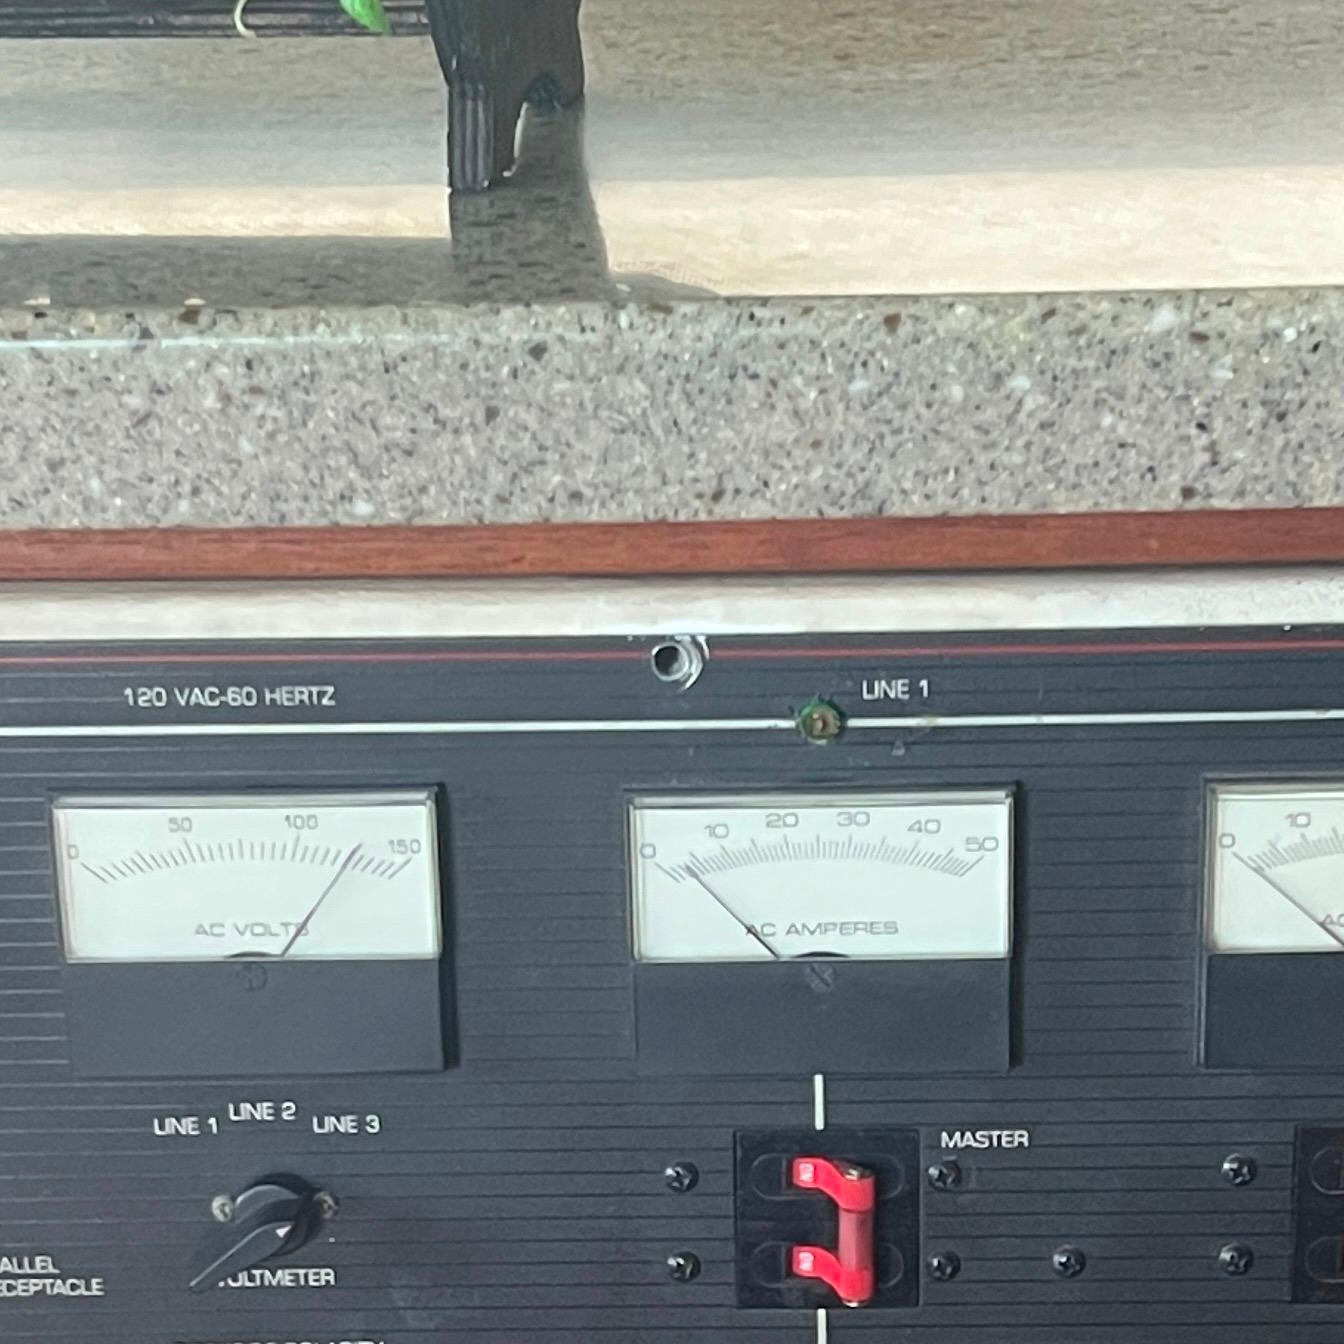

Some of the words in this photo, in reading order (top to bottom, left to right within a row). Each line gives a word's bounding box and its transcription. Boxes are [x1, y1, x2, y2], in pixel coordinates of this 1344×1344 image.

[124, 687, 166, 707] 120
[174, 687, 258, 707] VAC-60
[265, 686, 335, 706] HERTZ
[862, 680, 910, 699] LINE
[920, 680, 929, 698] 1
[168, 817, 193, 833] 50
[284, 815, 318, 830] 100
[765, 812, 800, 828] 20
[836, 812, 871, 827] 30
[907, 819, 941, 834] 40
[1284, 812, 1311, 827] 10
[704, 824, 730, 838] 10
[388, 839, 421, 855] 150
[965, 836, 999, 852] 50
[195, 923, 225, 937] AC
[745, 922, 777, 936] AC
[785, 920, 899, 936] AMPERES
[229, 1104, 274, 1121] LINE
[282, 1103, 297, 1119] 2
[154, 1118, 199, 1135] LINE
[208, 1118, 218, 1134] 1
[312, 1116, 358, 1133] LINE
[366, 1116, 381, 1133] 3
[941, 1131, 1030, 1148] MASTER
